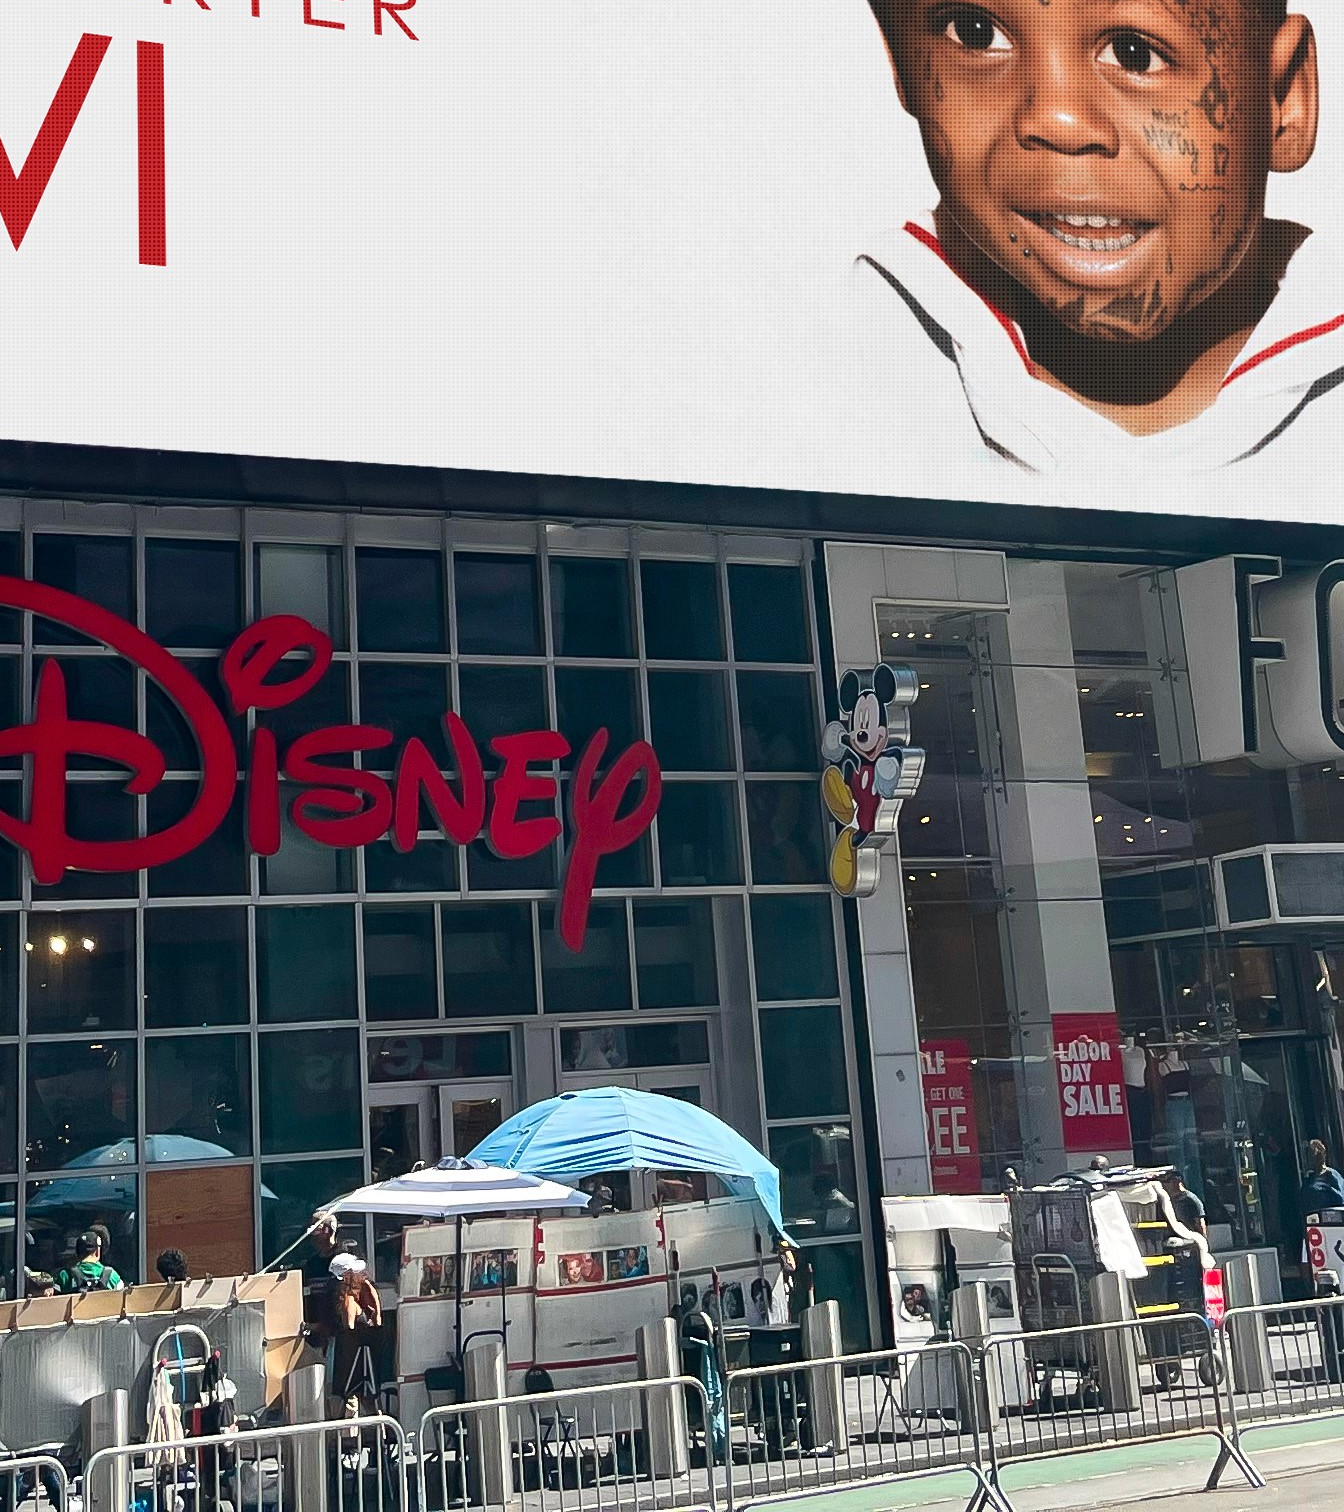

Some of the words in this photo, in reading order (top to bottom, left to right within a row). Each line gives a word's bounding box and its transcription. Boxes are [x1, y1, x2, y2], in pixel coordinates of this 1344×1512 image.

[1058, 1042, 1111, 1062] LABOR
[1060, 1064, 1091, 1083] DAY
[931, 1088, 946, 1100] GET
[1063, 1084, 1123, 1117] SALE
[927, 1106, 971, 1156] EE
